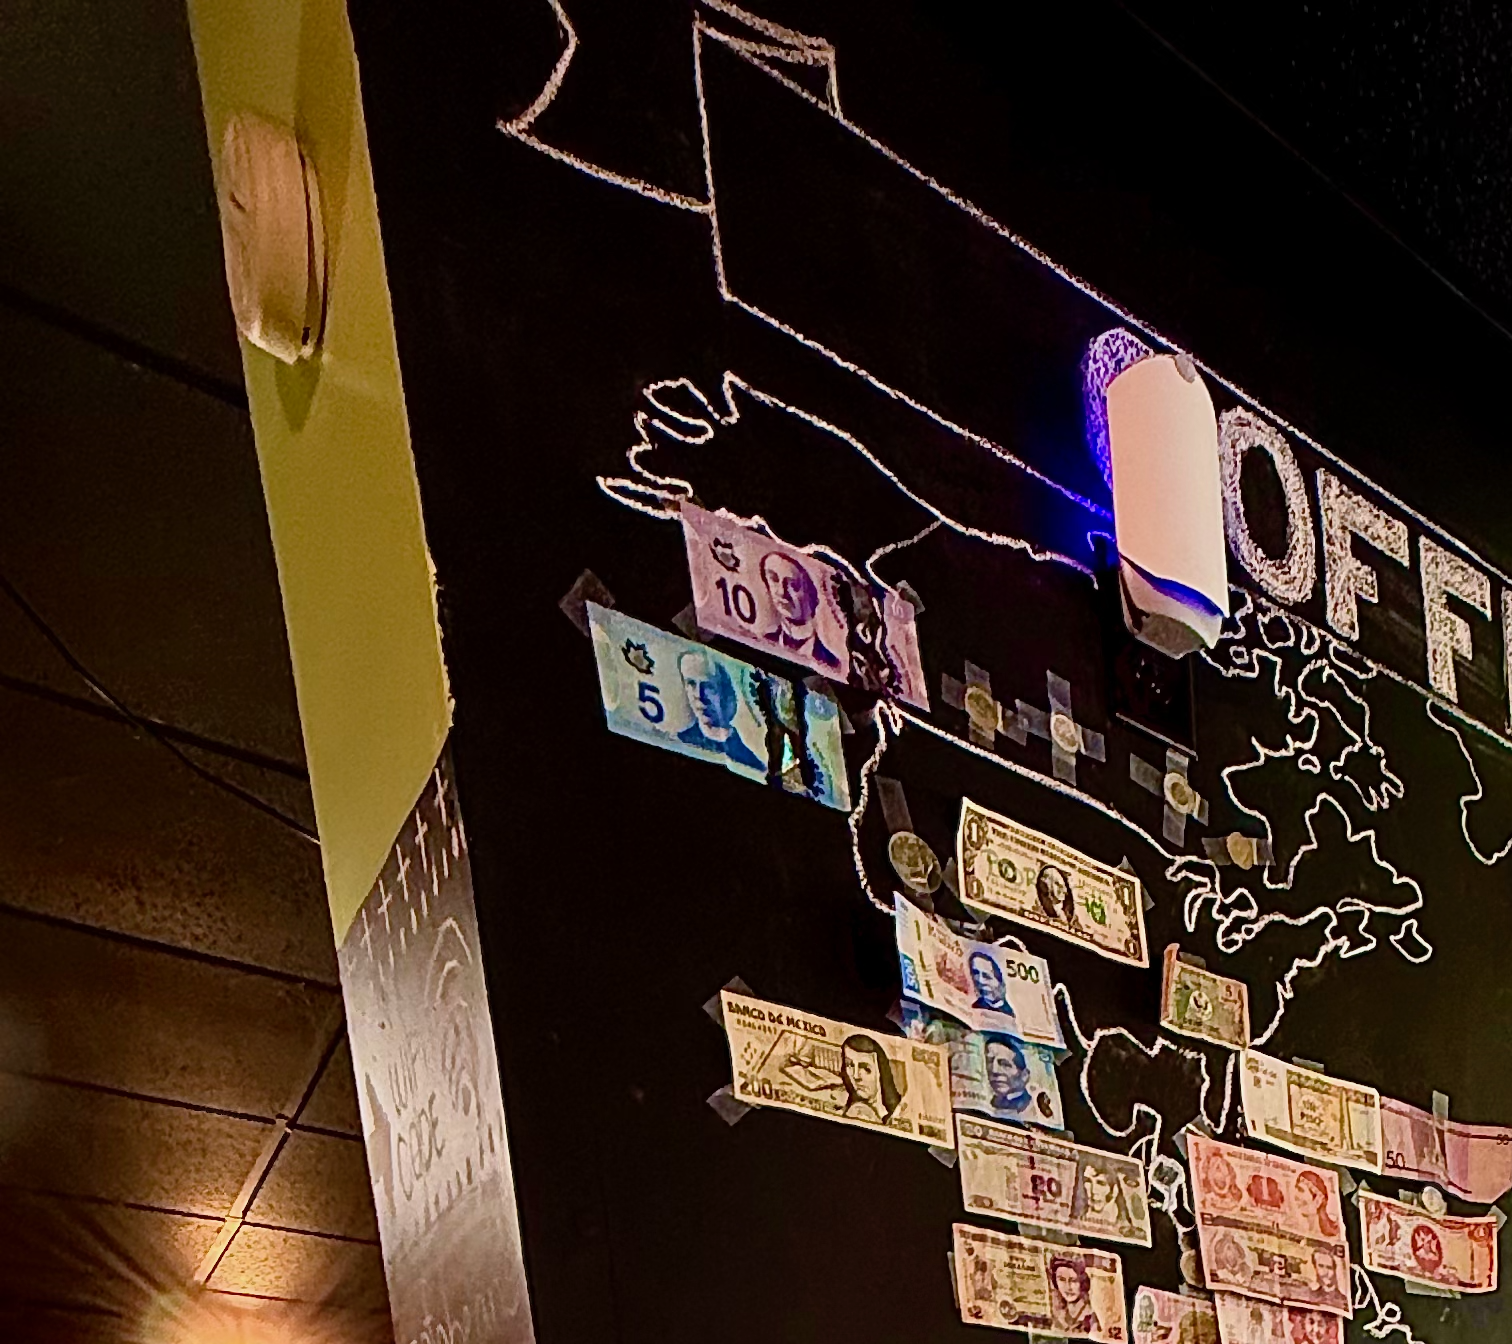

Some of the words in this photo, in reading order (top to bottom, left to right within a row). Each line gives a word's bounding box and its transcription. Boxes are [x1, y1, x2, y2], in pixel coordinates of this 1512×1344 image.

[716, 577, 756, 624] 10
[638, 681, 664, 724] 5
[1006, 959, 1040, 984] 500
[727, 1001, 766, 1022] BANCO
[768, 1011, 784, 1025] DE
[738, 1070, 773, 1101] 200
[1386, 1152, 1406, 1169] 50
